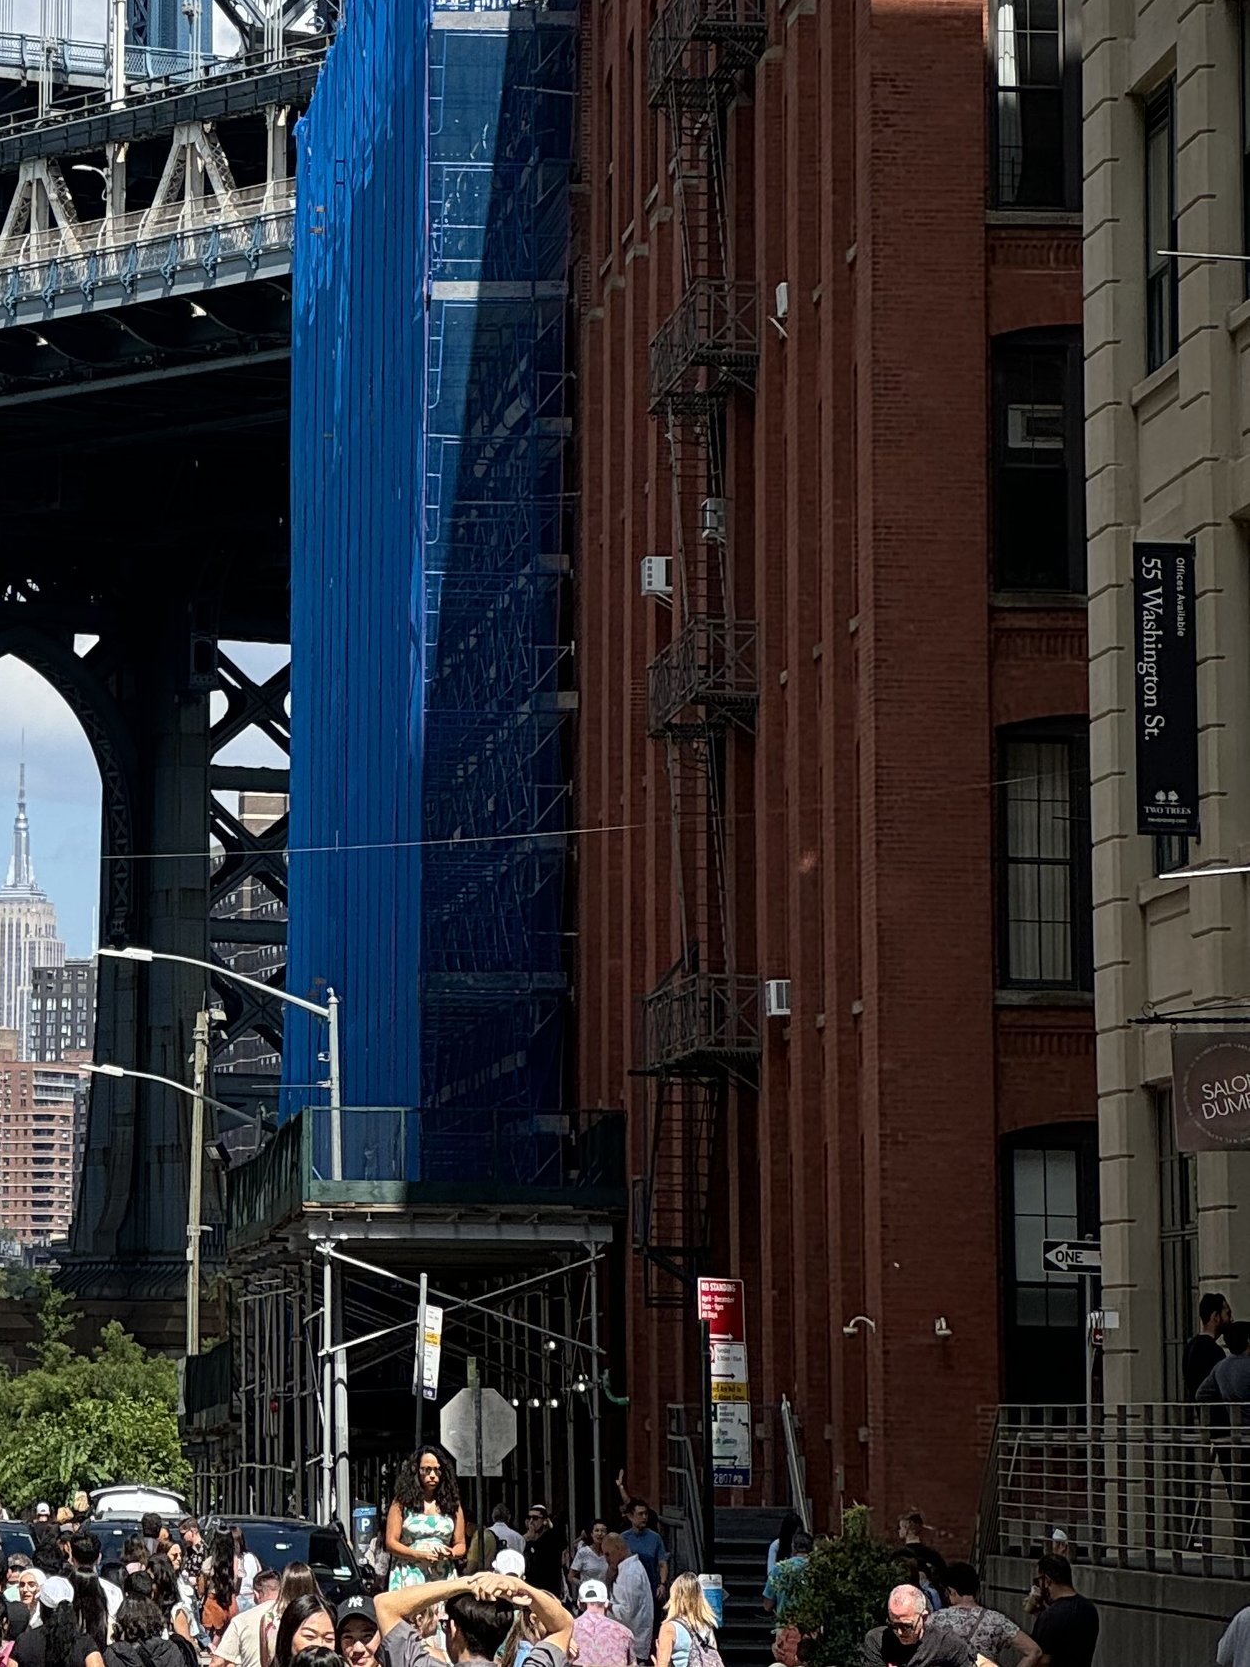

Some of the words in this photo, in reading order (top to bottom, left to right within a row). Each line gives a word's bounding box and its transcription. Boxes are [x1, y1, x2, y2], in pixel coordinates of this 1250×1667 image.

[1141, 556, 1162, 580] 55
[1176, 557, 1185, 591] Offices
[1177, 594, 1186, 637] Available
[1137, 586, 1164, 708] Washington
[1144, 715, 1165, 741] St.
[1143, 806, 1164, 814] TWO
[1164, 806, 1191, 814] TREES
[1055, 1250, 1084, 1264] ONE
[361, 1517, 370, 1532] P
